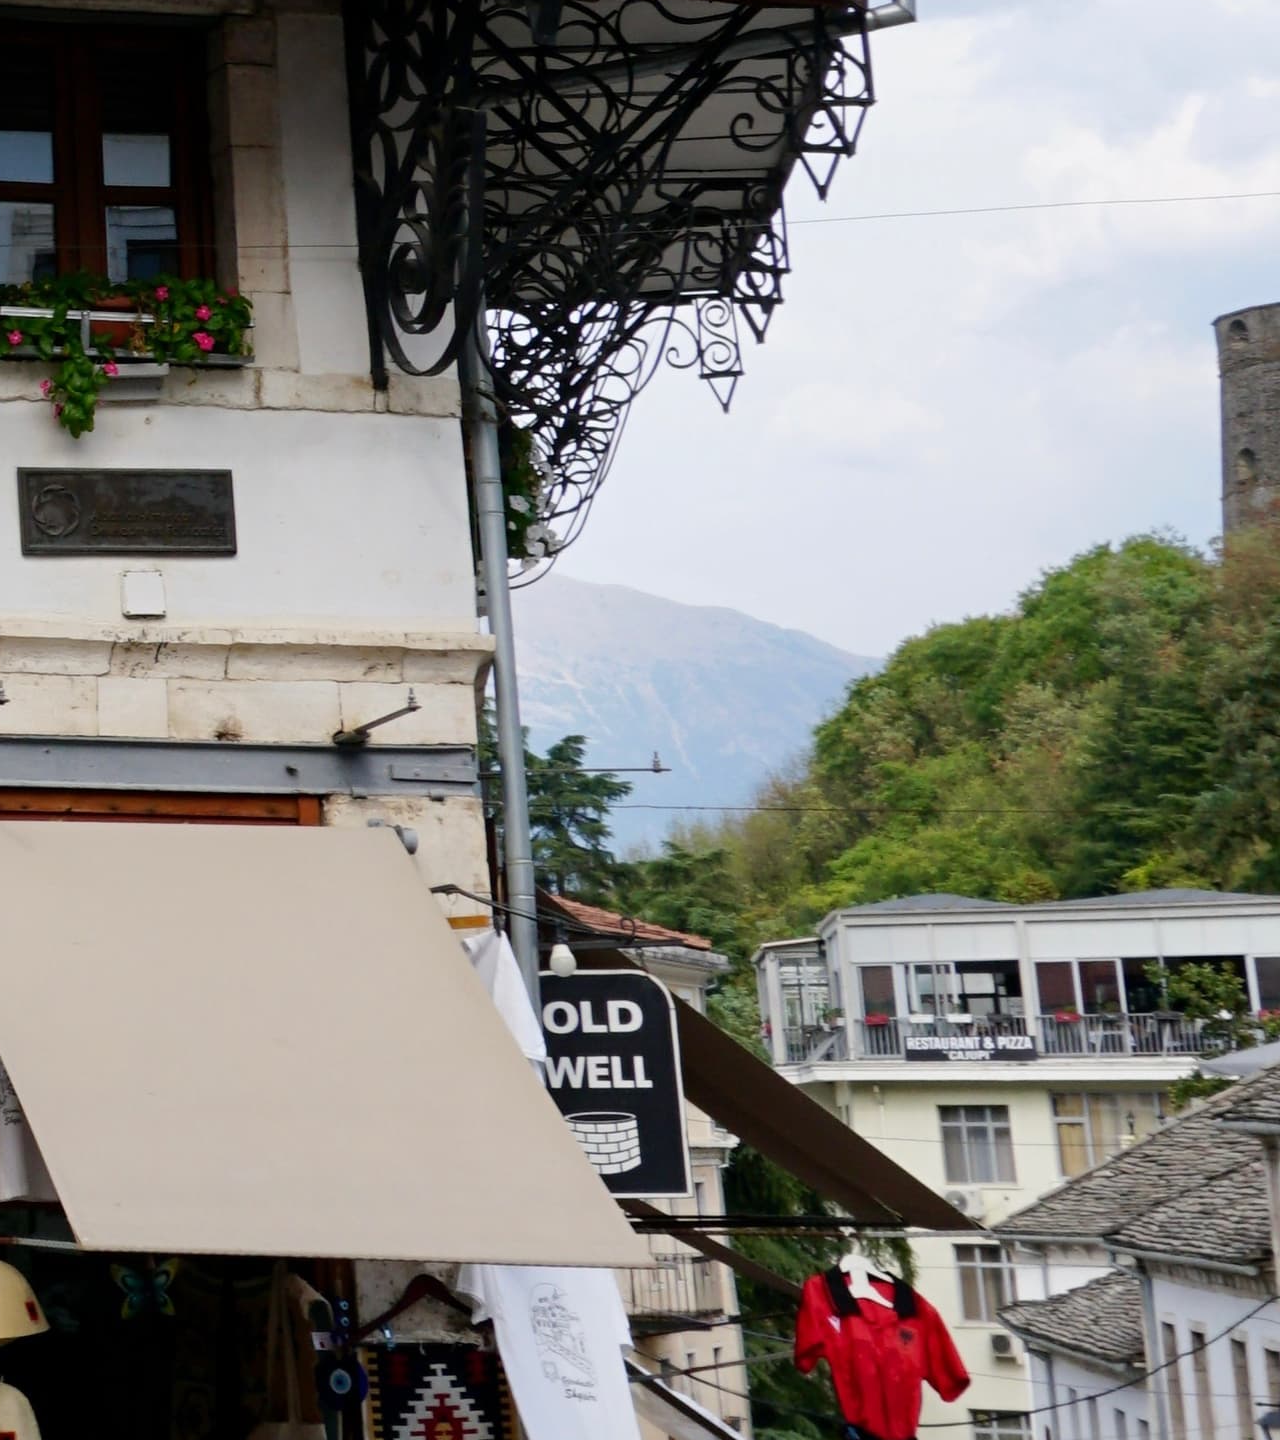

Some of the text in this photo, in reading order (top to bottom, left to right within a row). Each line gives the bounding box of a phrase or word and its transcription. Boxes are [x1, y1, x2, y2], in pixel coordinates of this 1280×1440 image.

[543, 999, 643, 1035] OLD
[907, 1035, 1033, 1051] RESTAURANT & PIZZA
[546, 1054, 653, 1089] WELL
